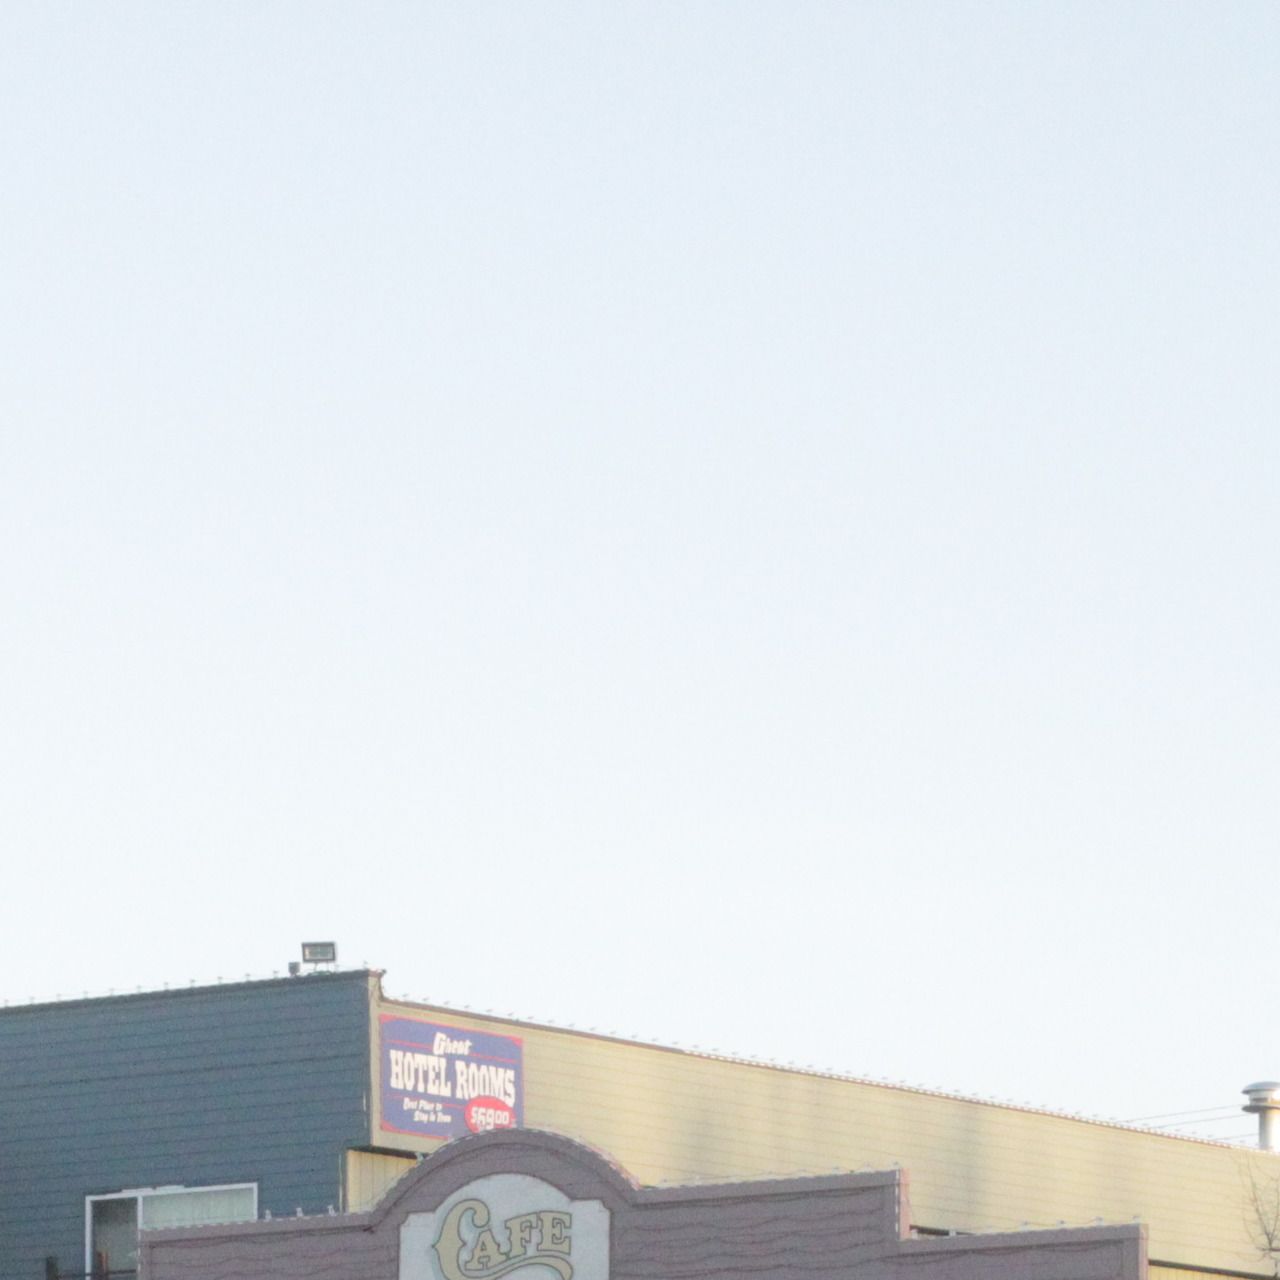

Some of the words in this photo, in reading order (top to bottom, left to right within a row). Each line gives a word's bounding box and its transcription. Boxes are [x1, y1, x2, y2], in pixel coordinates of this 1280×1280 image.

[433, 1032, 472, 1055] Great
[390, 1049, 451, 1097] HOTEL
[455, 1060, 515, 1108] ROOMS
